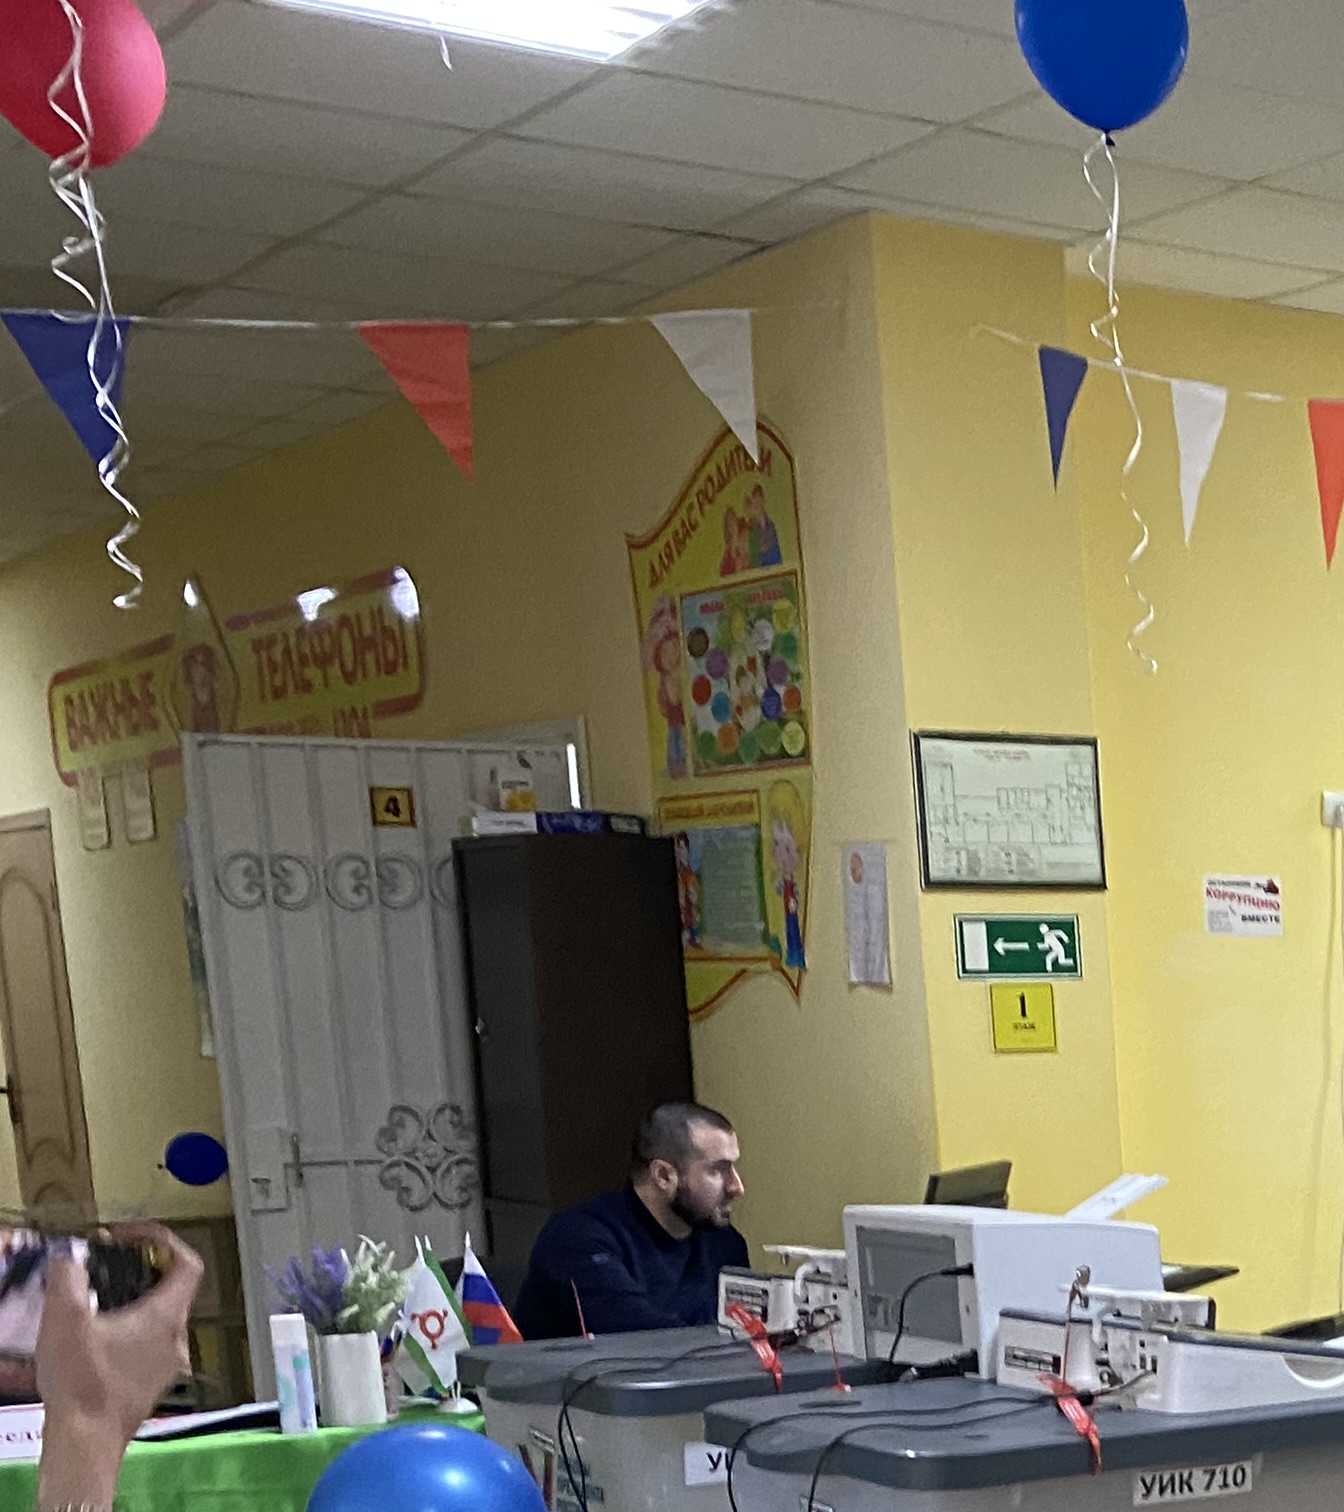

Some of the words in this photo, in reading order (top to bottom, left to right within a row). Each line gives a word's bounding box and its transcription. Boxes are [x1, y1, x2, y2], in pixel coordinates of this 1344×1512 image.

[252, 605, 408, 702] ТЕЛЕФОНЫ
[385, 795, 401, 817] 4
[1206, 886, 1280, 911] КОРРУПЦИЮ
[1016, 992, 1027, 1018] 1
[1140, 1468, 1193, 1500] УИК
[1202, 1463, 1246, 1492] 710
